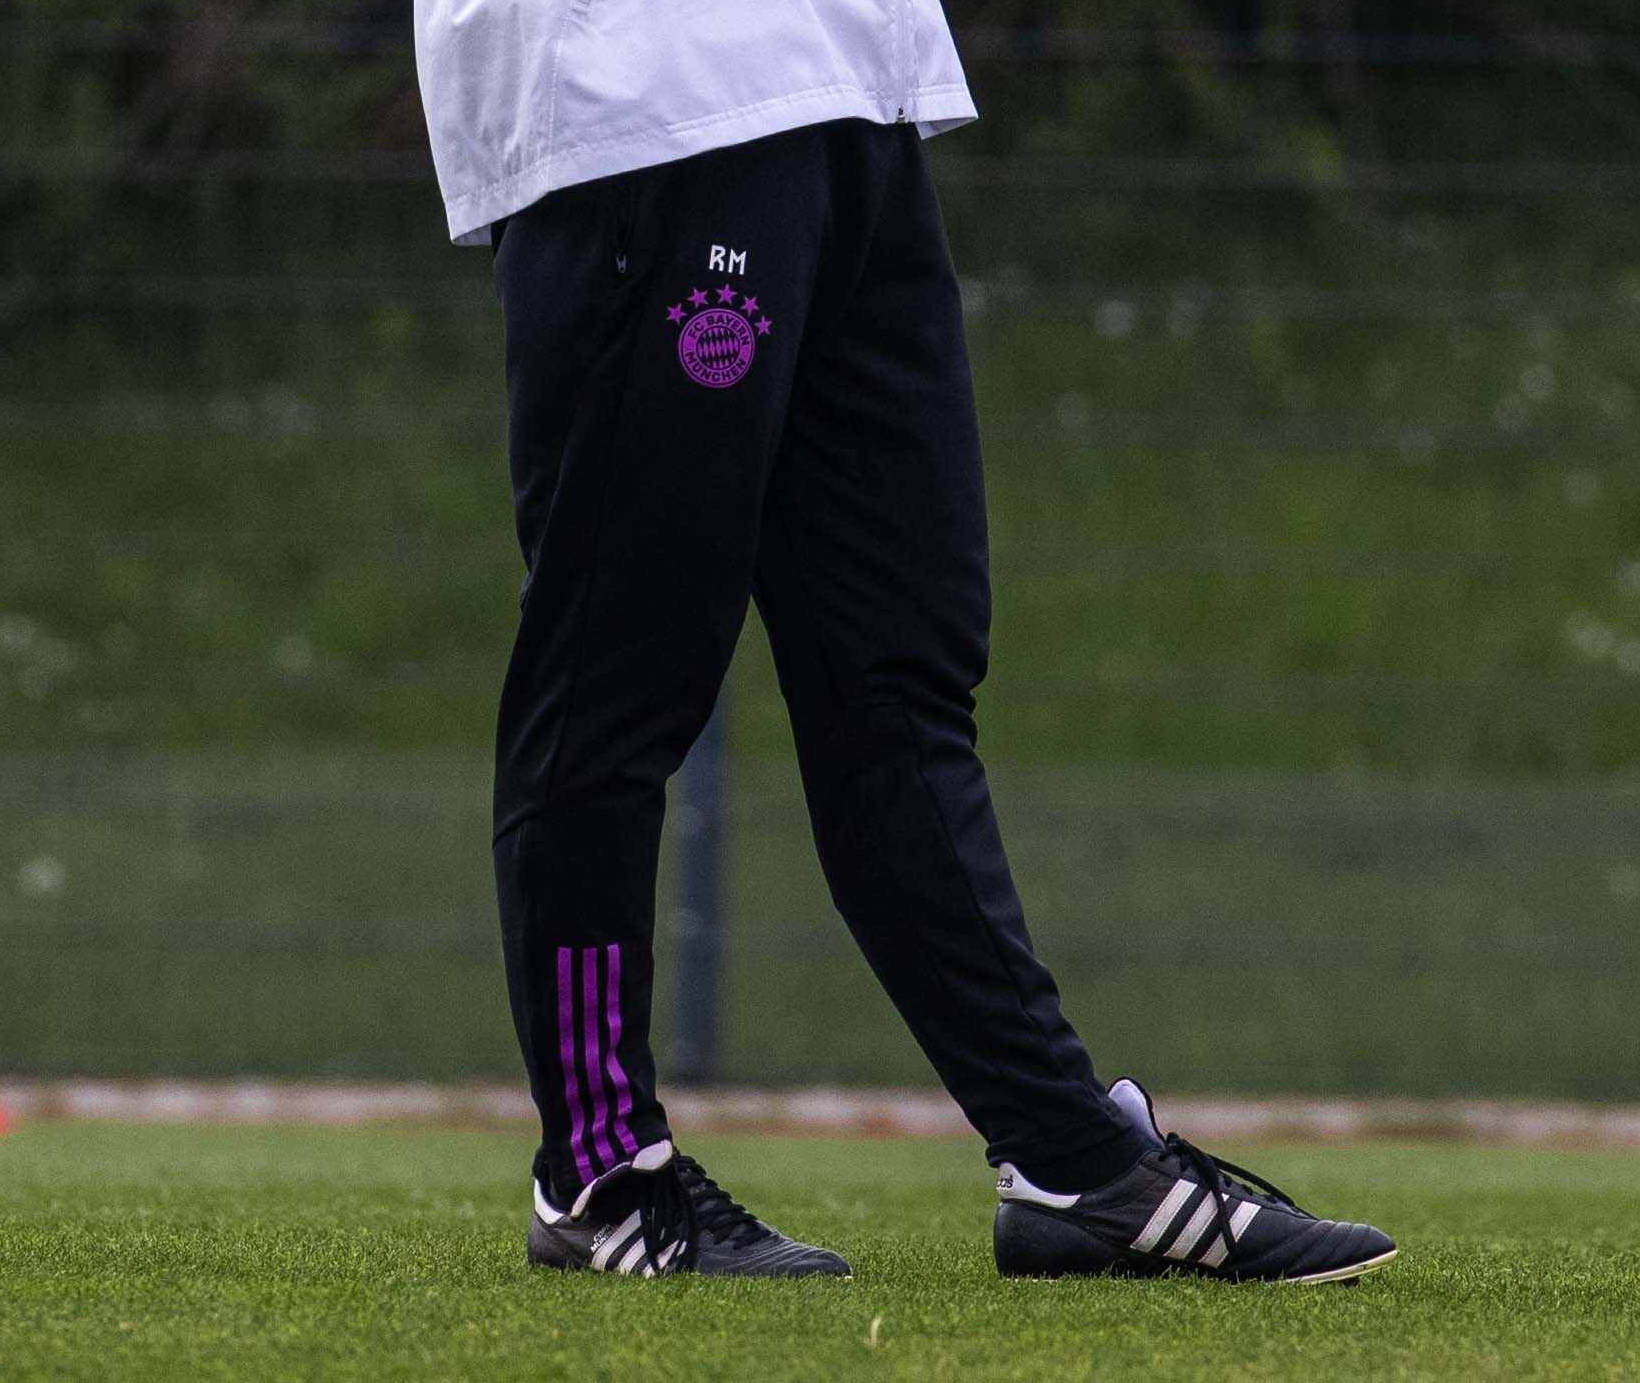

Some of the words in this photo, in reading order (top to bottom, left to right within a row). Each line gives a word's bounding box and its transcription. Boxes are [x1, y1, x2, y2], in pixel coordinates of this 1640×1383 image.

[709, 245, 747, 275] RM
[688, 321, 704, 339] FC
[706, 315, 750, 345] BAYERN
